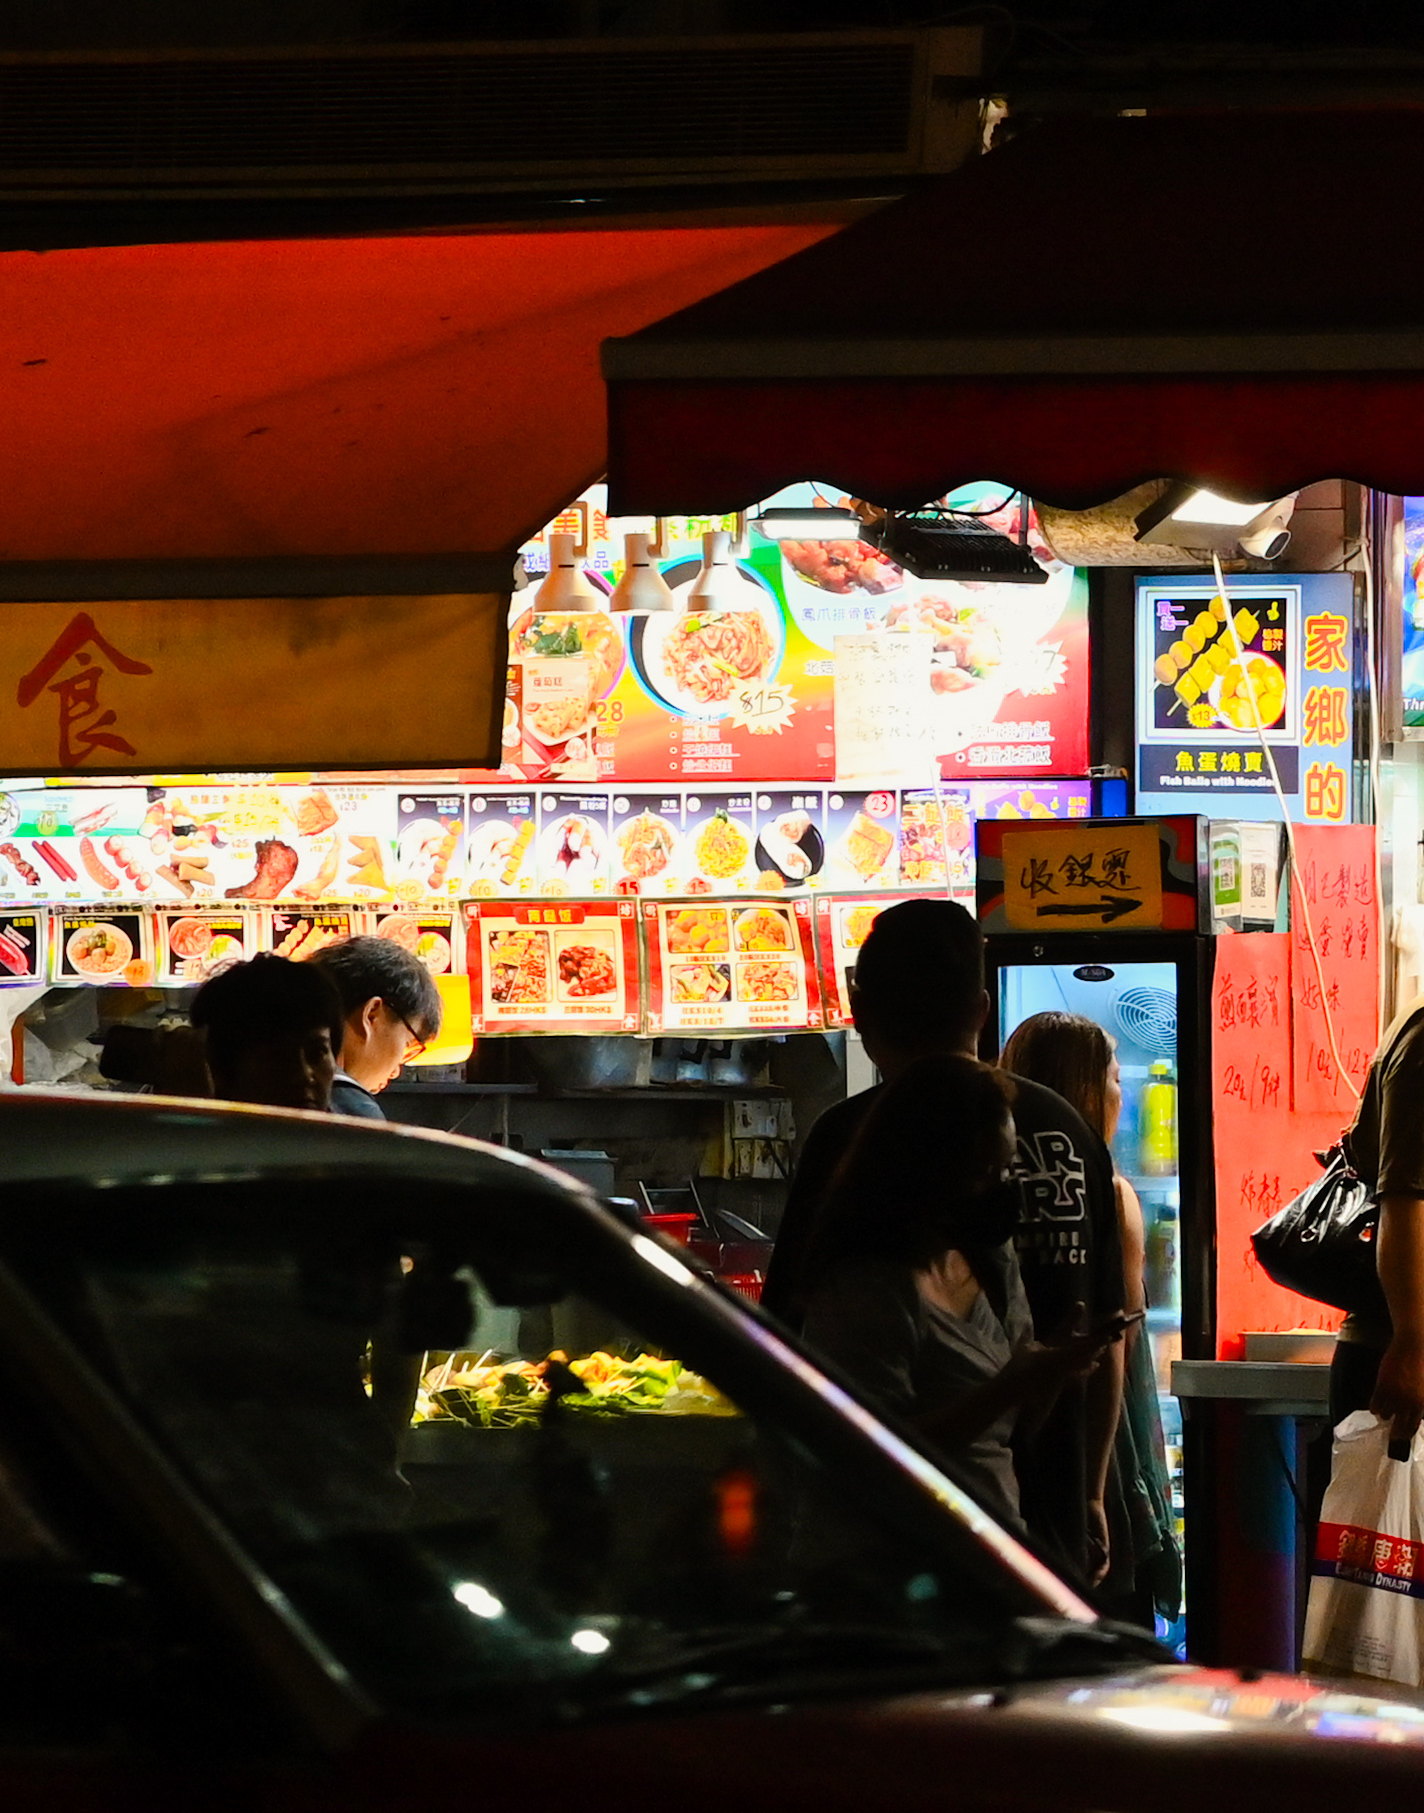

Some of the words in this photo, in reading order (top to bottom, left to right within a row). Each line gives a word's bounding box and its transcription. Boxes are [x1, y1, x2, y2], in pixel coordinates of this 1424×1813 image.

[16, 611, 154, 766] 食
[1304, 611, 1349, 822] 家鄉的
[1174, 751, 1265, 774] 魚蛋燒賣
[870, 794, 890, 814] 23
[1010, 1130, 1086, 1175] AR
